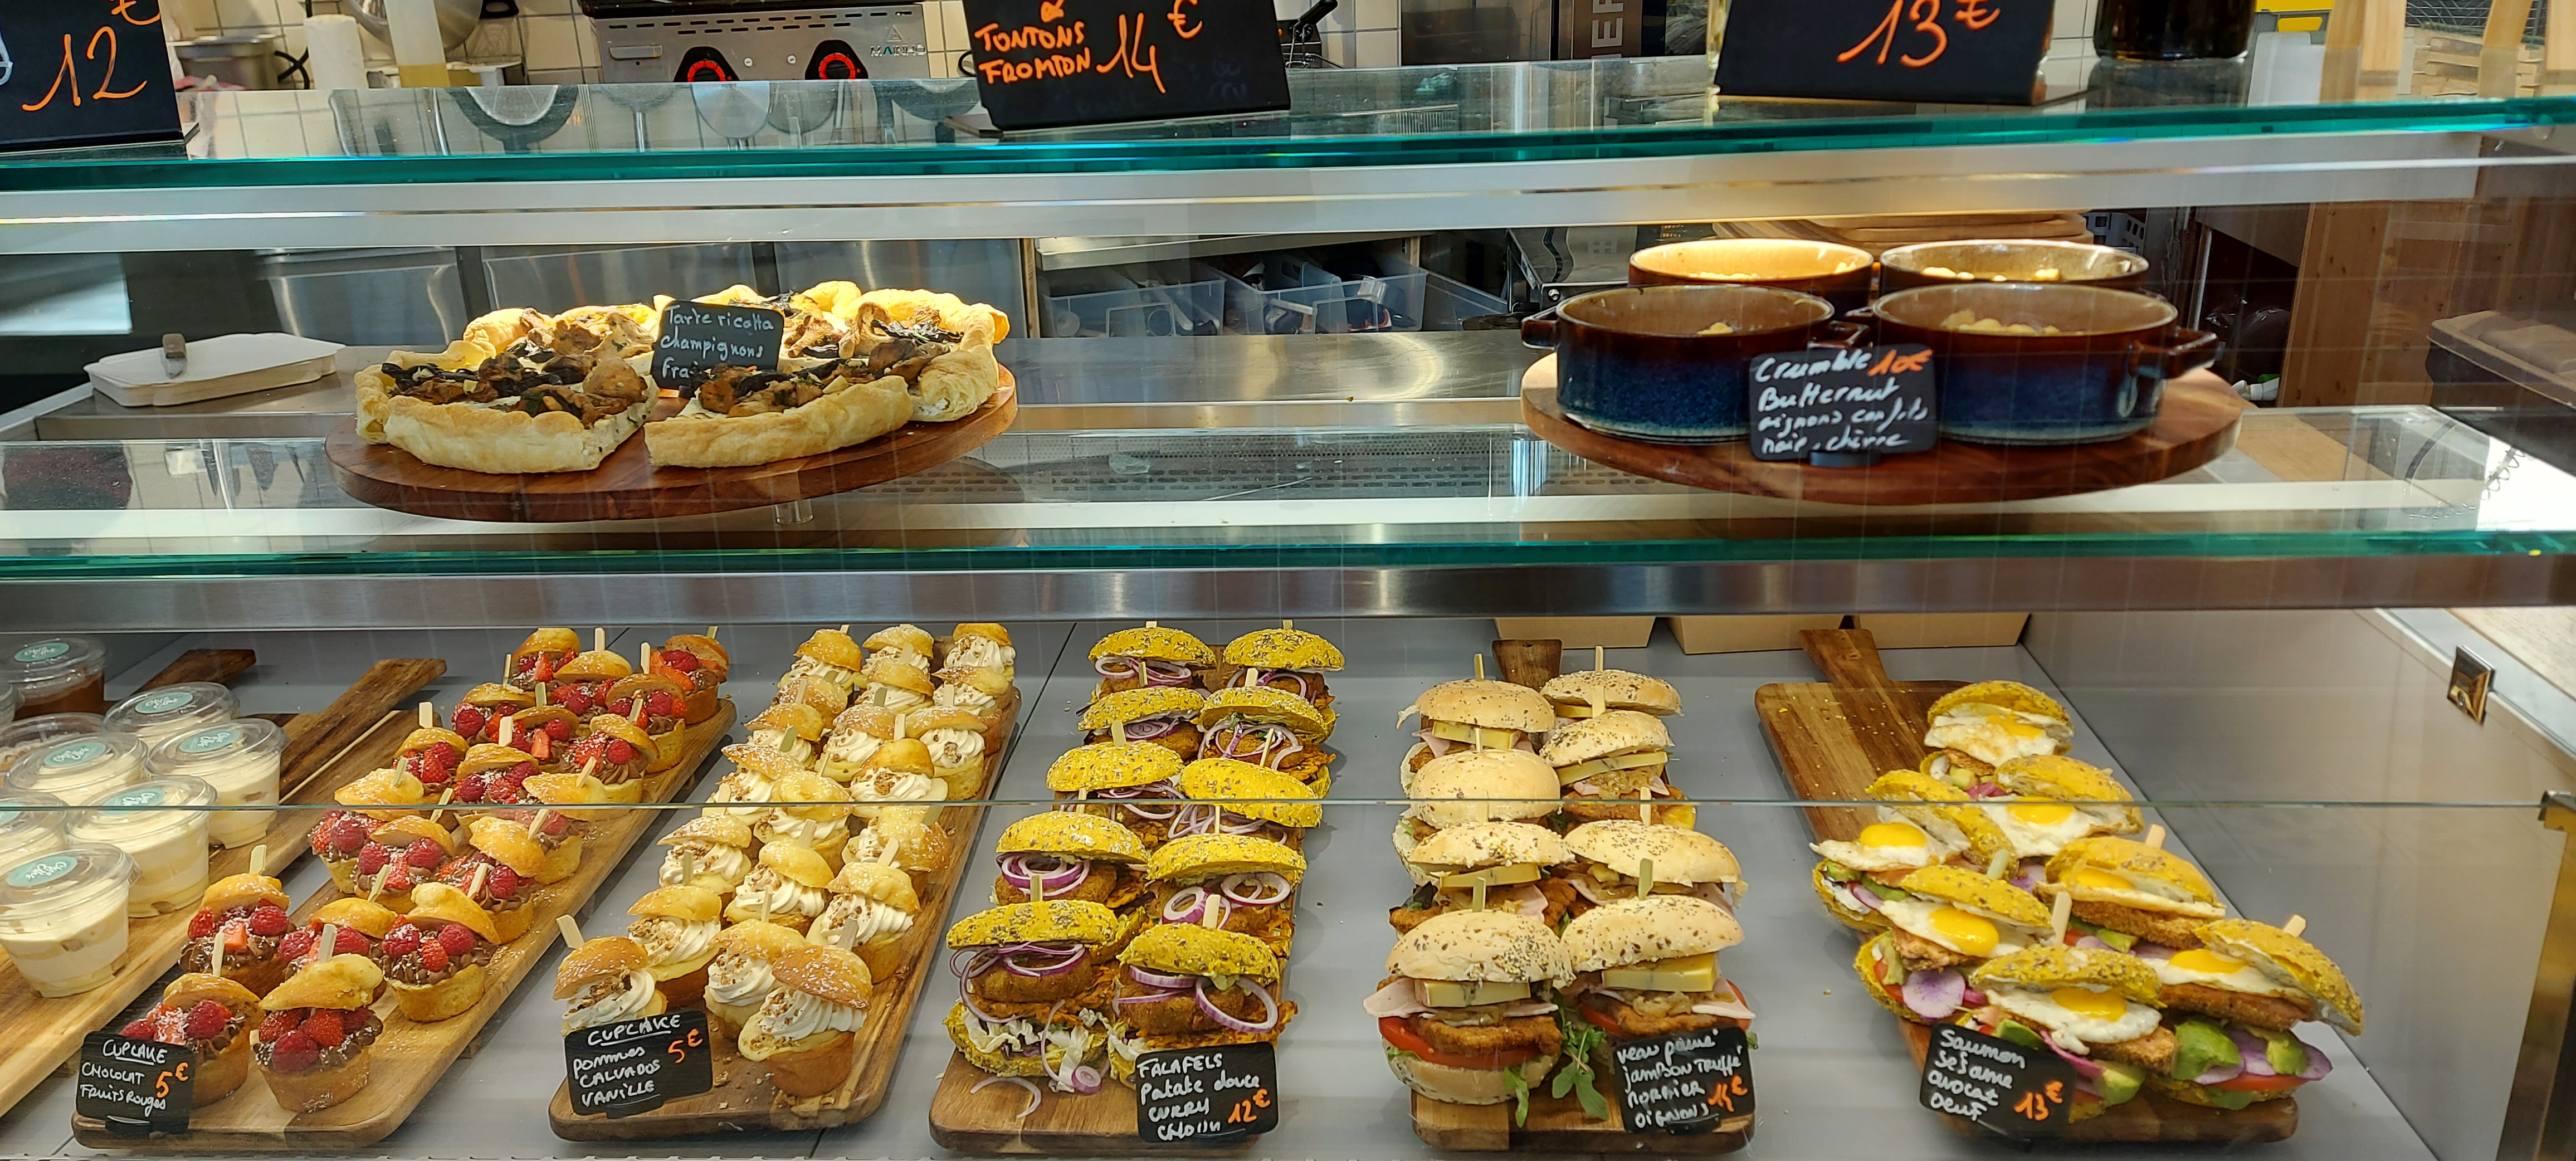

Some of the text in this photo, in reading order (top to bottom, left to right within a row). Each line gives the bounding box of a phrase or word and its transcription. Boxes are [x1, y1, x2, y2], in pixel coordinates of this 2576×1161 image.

[974, 21, 1085, 52] TONTONS
[663, 305, 774, 331] Tarte ricotta
[1755, 348, 1872, 383] Crumble
[587, 1014, 681, 1046] CUPCAKE
[103, 1039, 168, 1064] CUPCAKE
[1940, 1029, 2026, 1070] Saumon
[579, 1059, 661, 1088] CALVADOS
[1136, 1053, 1223, 1078] FALAFELS
